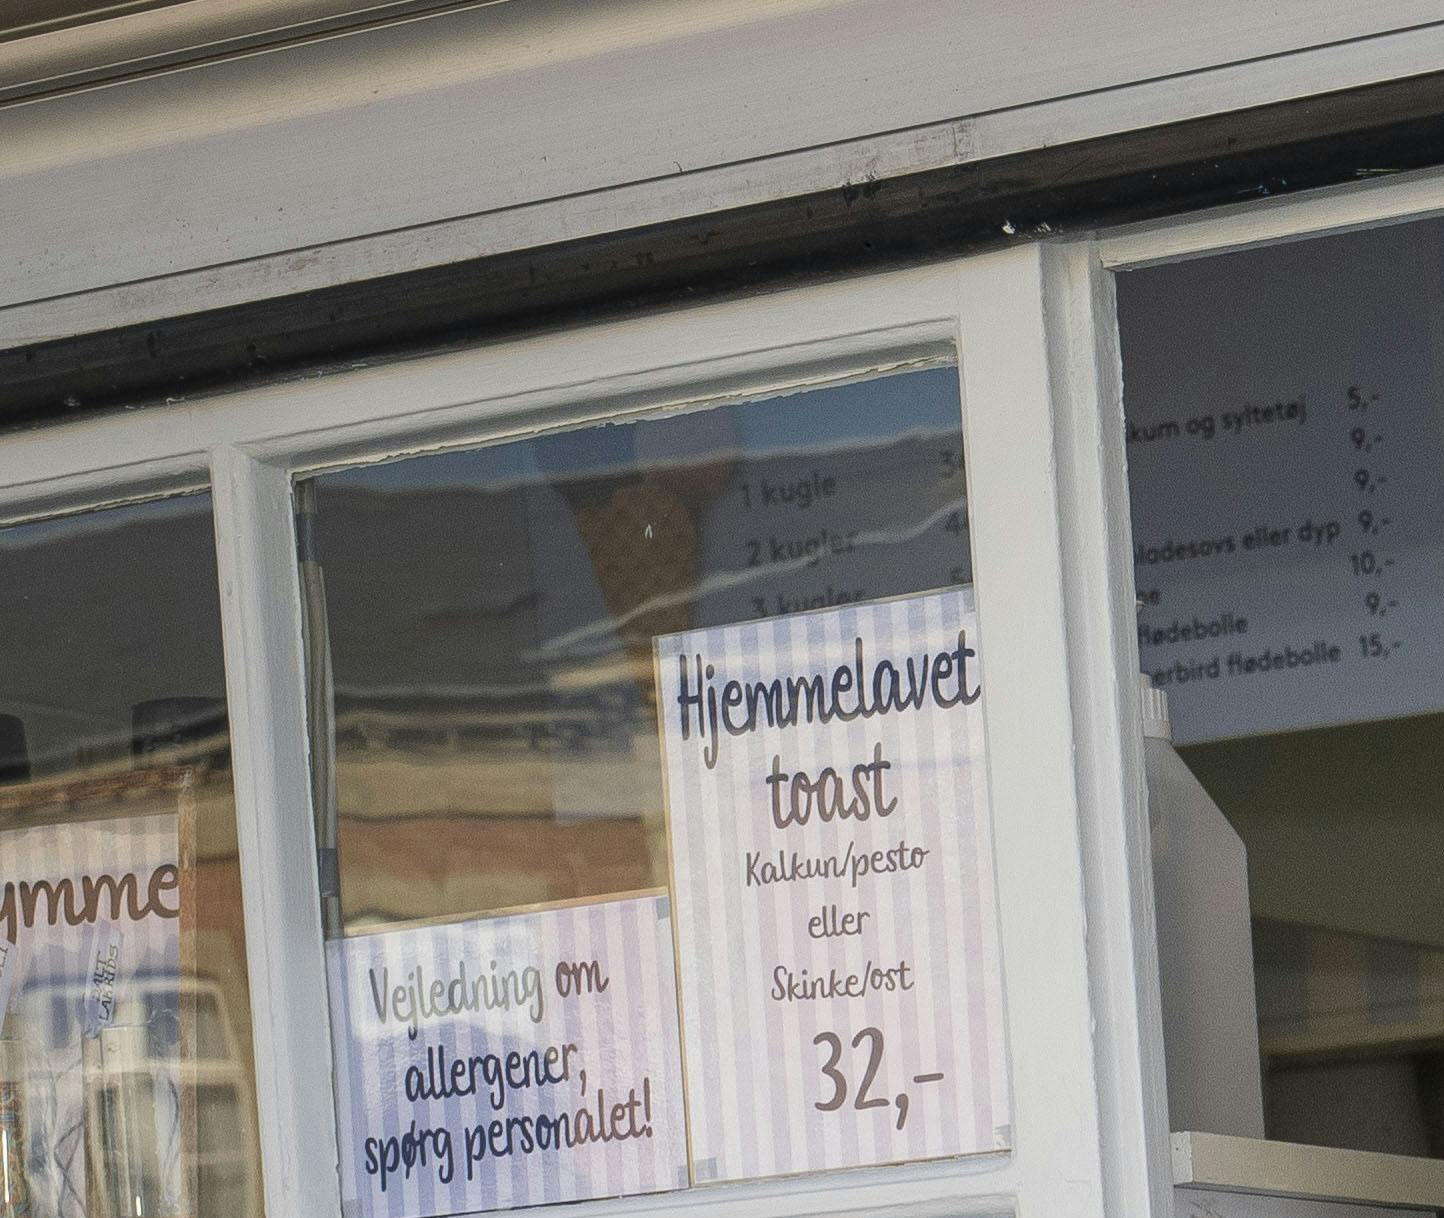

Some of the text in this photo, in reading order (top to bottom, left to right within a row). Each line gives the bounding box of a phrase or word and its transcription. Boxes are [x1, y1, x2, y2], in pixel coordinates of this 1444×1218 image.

[1127, 418, 1180, 443] kum
[1186, 416, 1215, 440] og
[1351, 427, 1384, 453] 9,-
[1355, 468, 1388, 493] 9,-
[1242, 525, 1290, 550] eller
[1298, 519, 1340, 547] dyp
[1358, 509, 1392, 534] 9,-
[1349, 551, 1395, 576] 10,-
[1365, 592, 1398, 617] 9,-
[1227, 641, 1342, 675] flødebolle
[1359, 633, 1401, 658] 15,-
[677, 629, 981, 769] Hjemmelavet
[766, 743, 898, 829] toast
[745, 840, 929, 888] Kalkun/pesto
[808, 907, 870, 939] eller
[369, 957, 610, 1039] Vejledning om
[771, 960, 914, 1001] Skinke/ost
[405, 1040, 587, 1111] allergener,
[813, 1026, 944, 1131] 32,-
[365, 1077, 653, 1191] spørg personalet!
